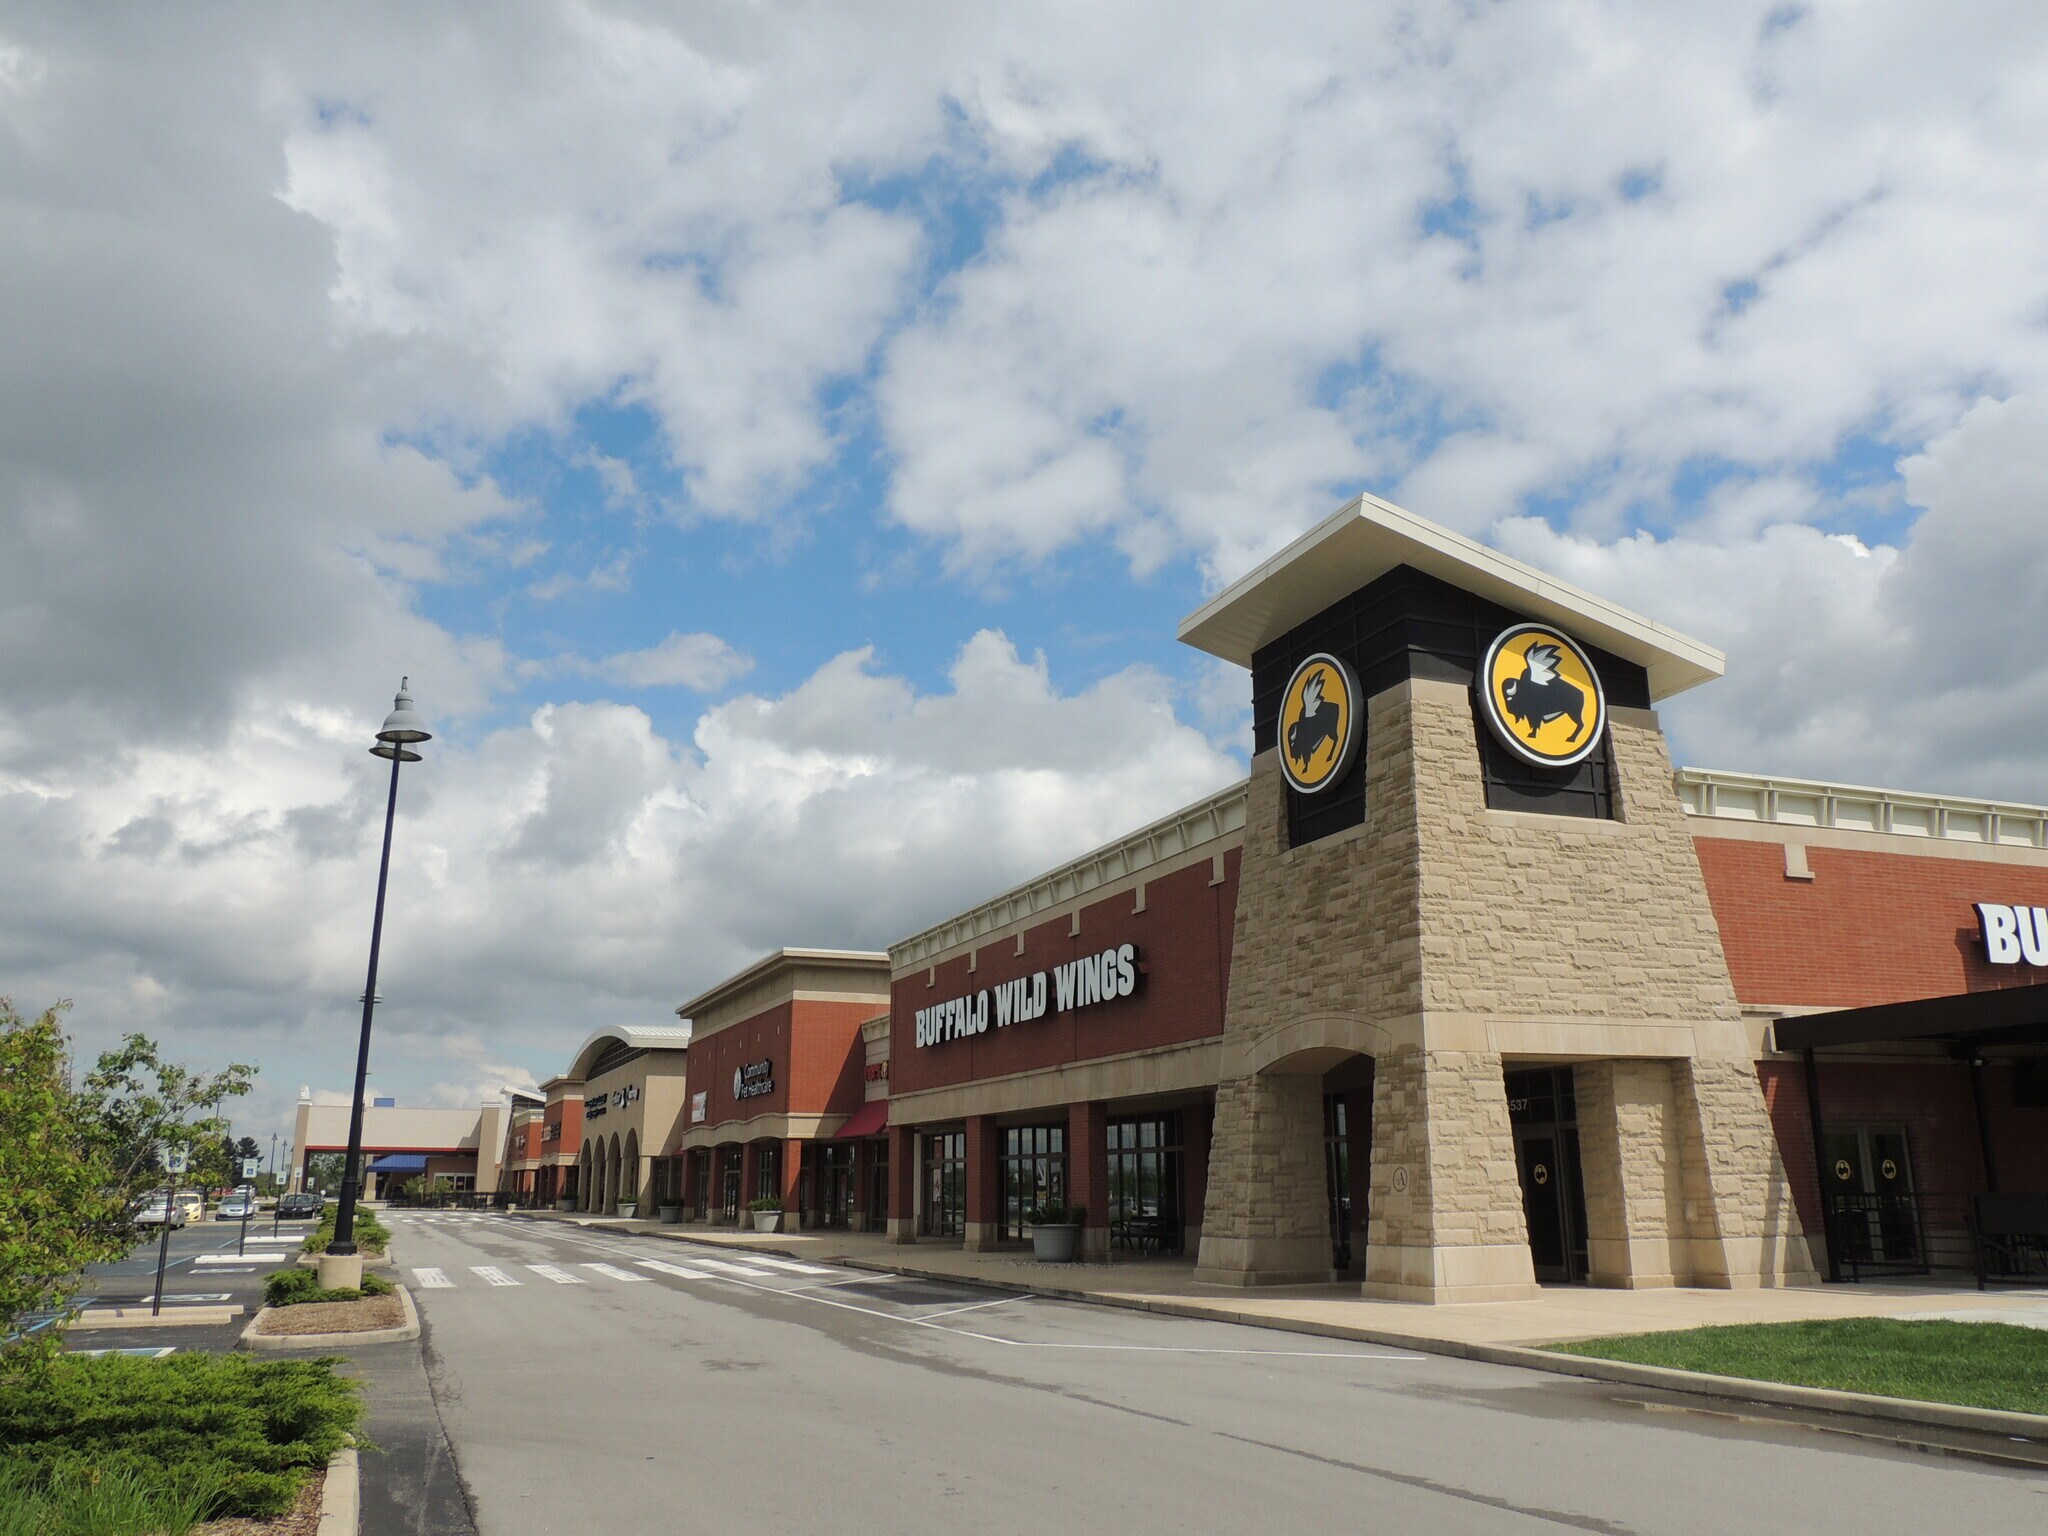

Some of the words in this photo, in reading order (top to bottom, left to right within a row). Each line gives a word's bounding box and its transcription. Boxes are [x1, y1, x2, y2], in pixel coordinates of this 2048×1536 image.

[1977, 903, 2048, 967] BU
[915, 989, 988, 1048] BUFFALO
[994, 971, 1047, 1028] WILD
[1053, 943, 1135, 1012] WINGS
